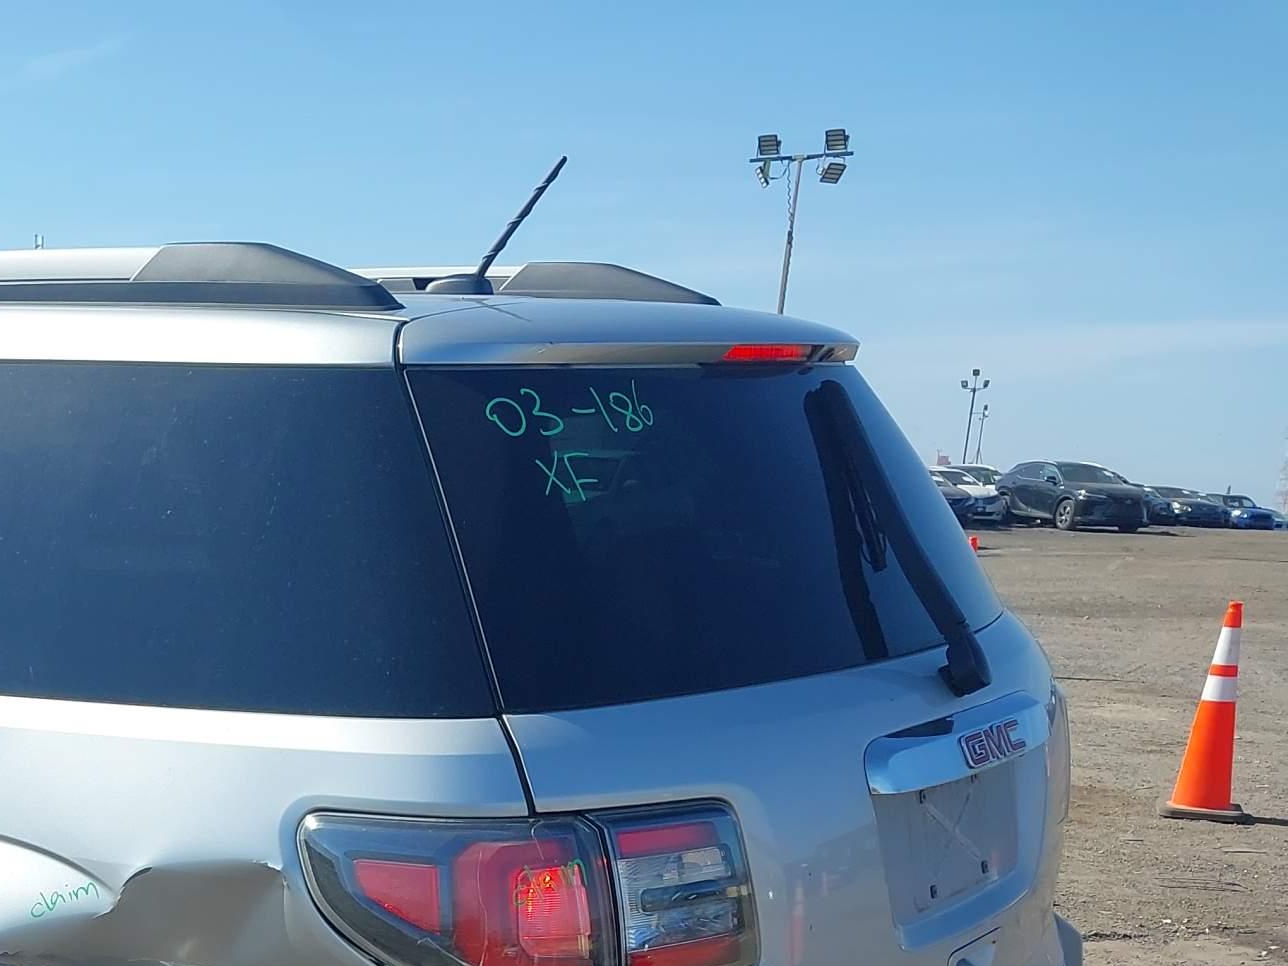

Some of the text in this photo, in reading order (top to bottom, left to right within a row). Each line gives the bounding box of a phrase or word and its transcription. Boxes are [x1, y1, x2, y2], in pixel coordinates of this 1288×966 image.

[485, 379, 655, 436] 03-186
[535, 450, 599, 502] XF
[959, 719, 1027, 769] GMC
[30, 880, 101, 919] claim
